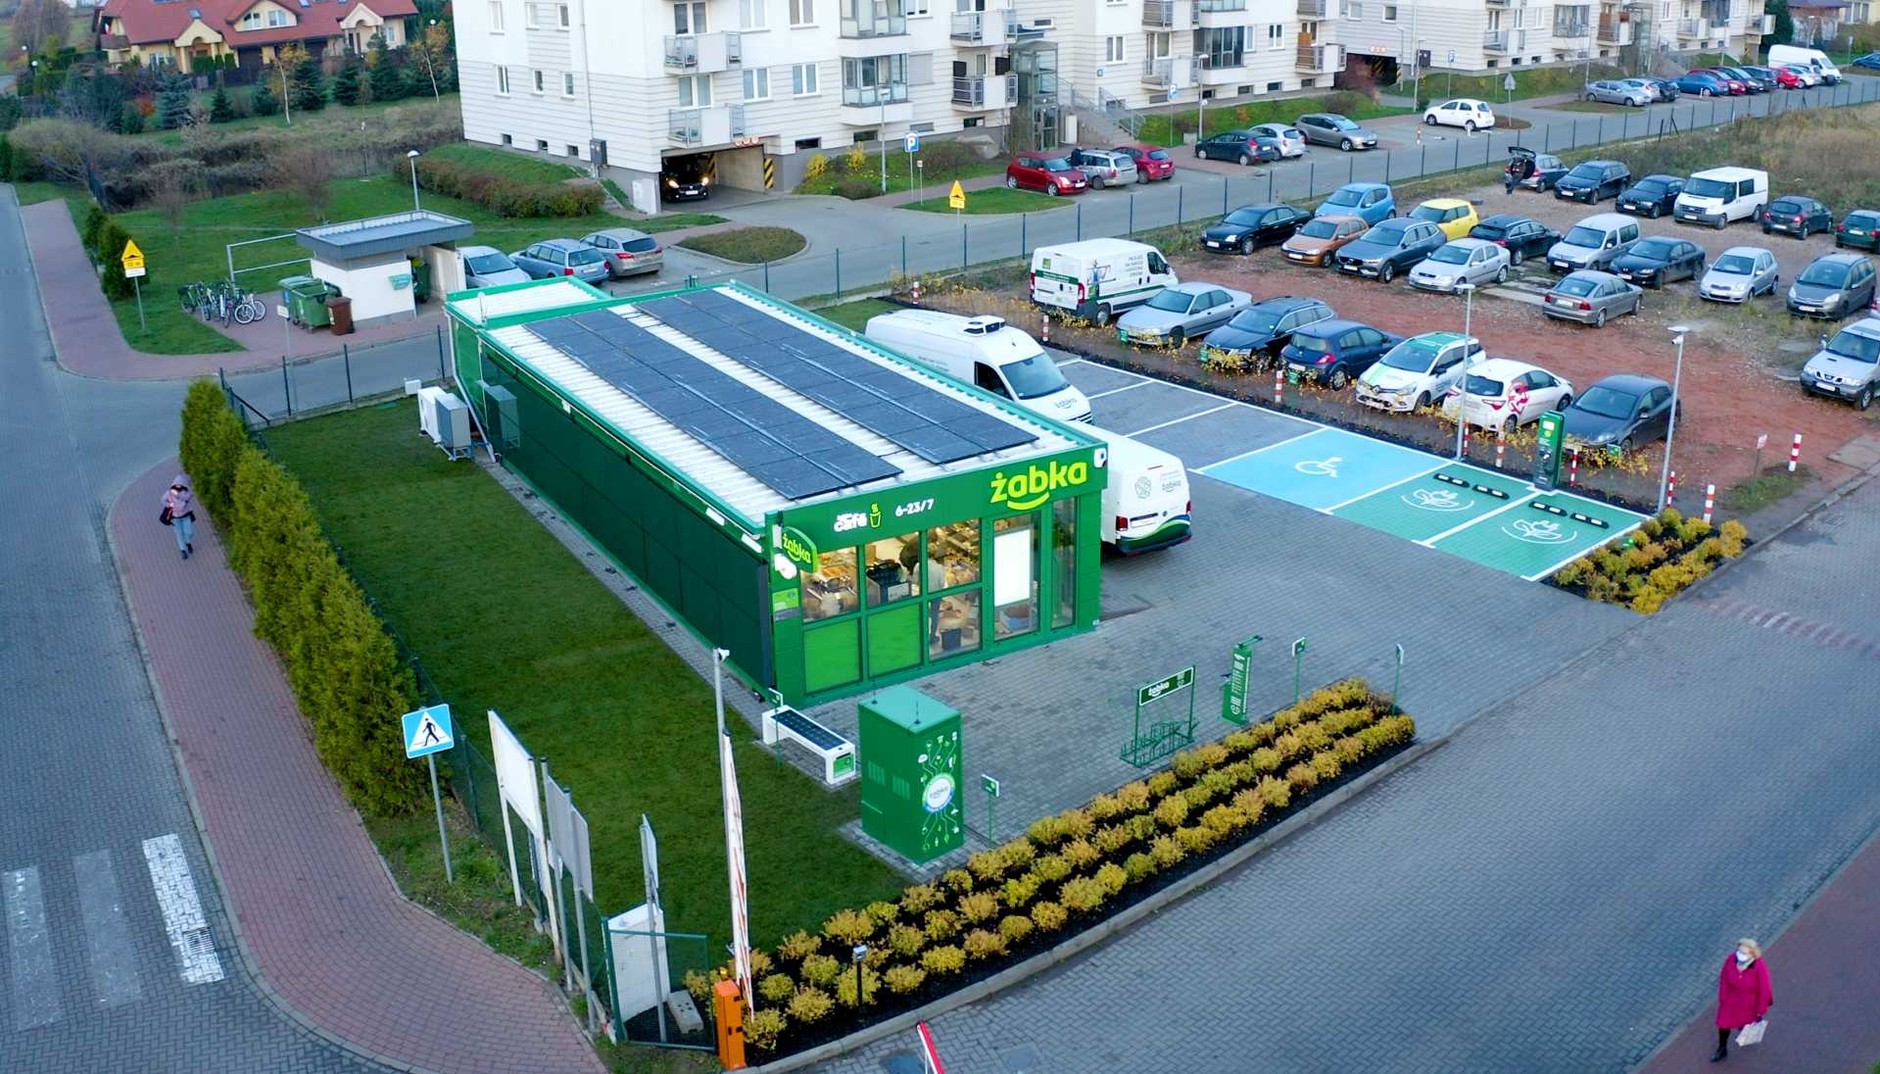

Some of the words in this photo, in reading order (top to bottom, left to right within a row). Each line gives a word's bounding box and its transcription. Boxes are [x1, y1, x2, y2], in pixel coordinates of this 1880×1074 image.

[990, 460, 1088, 504] żabka
[895, 498, 935, 517] 6-23/7
[782, 533, 811, 564] żabka
